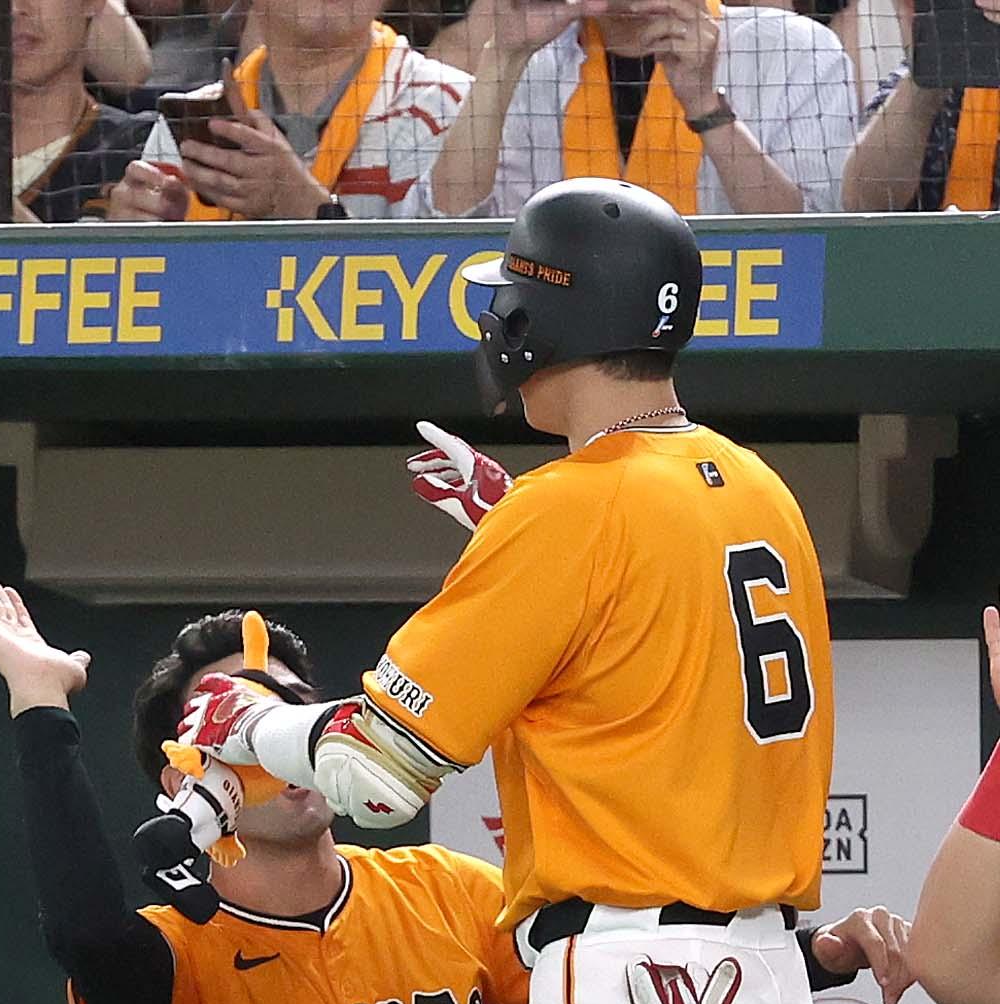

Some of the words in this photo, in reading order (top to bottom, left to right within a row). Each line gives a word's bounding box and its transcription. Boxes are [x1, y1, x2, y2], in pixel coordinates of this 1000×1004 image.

[537, 264, 572, 287] PRIDE
[657, 282, 679, 314] 6
[723, 540, 815, 745] 6
